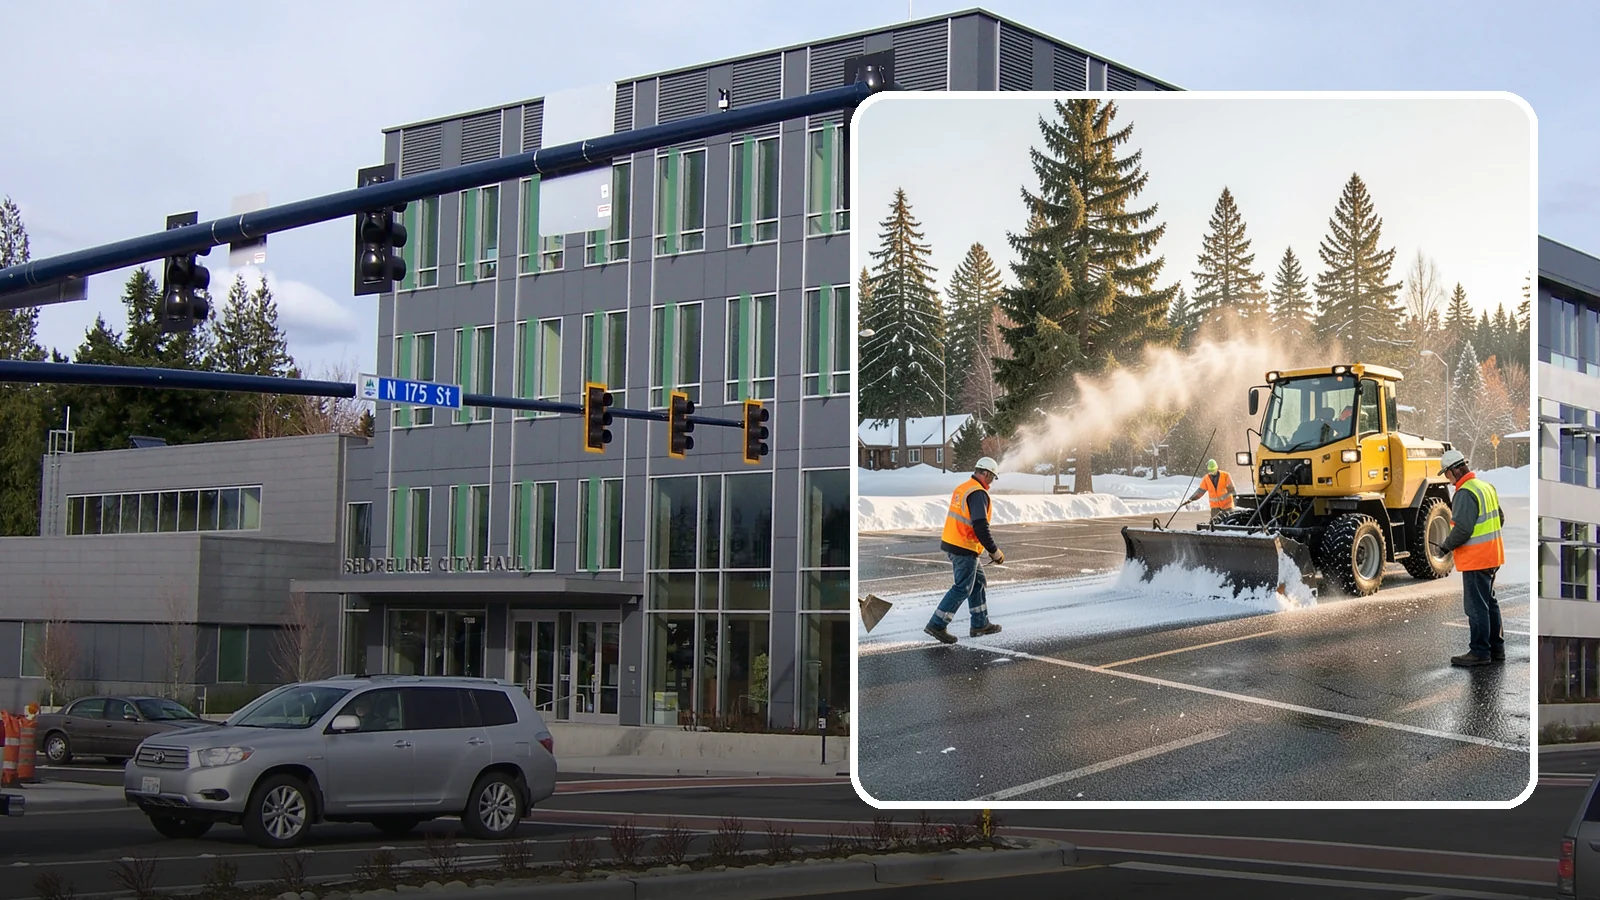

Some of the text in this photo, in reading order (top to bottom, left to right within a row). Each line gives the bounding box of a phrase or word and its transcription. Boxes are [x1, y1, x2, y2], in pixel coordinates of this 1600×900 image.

[387, 380, 451, 406] N 175 St
[344, 555, 525, 574] SHORELINE CITY HALL
